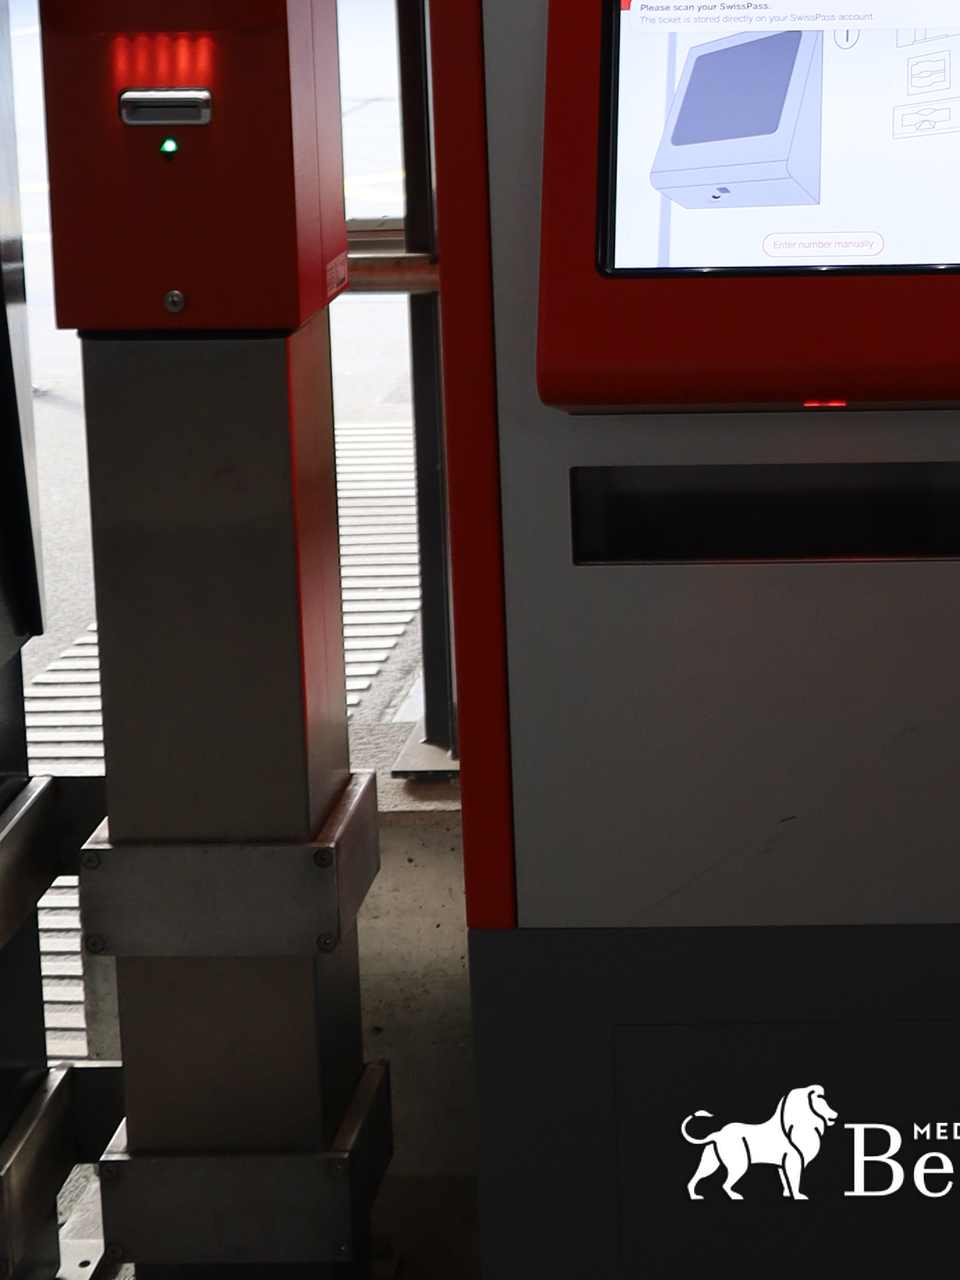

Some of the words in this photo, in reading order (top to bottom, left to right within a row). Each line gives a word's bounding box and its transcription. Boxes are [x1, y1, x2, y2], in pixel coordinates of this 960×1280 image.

[640, 3, 671, 12] Please
[673, 4, 695, 12] scan
[697, 3, 717, 13] your
[773, 240, 797, 249] Enter
[799, 239, 833, 249] number
[834, 238, 874, 251] manually
